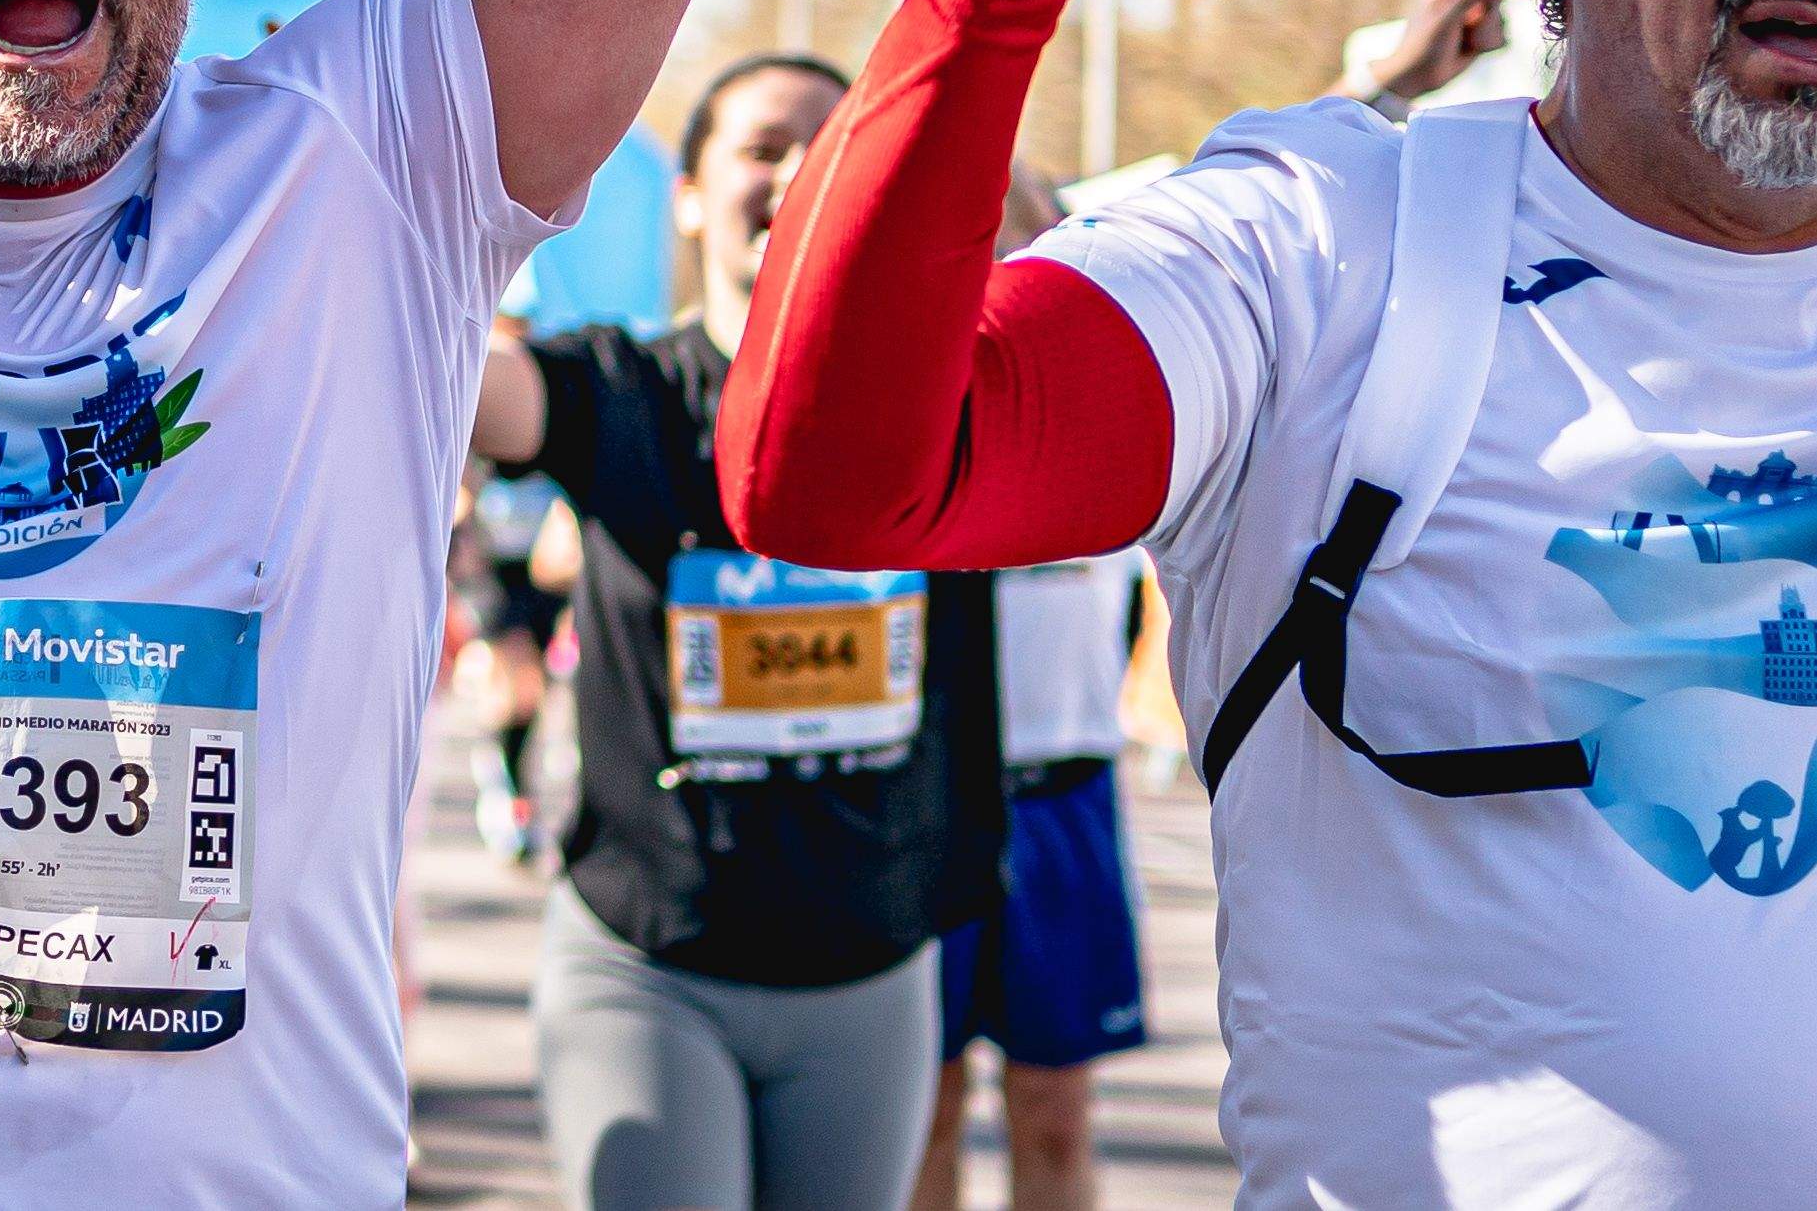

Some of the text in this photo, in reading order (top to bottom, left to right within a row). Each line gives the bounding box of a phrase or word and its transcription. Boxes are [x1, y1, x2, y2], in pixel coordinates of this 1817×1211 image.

[4, 628, 186, 669] Movistar
[15, 716, 64, 729] MEDIO
[67, 718, 137, 734] MARATÓN
[140, 723, 171, 737] 2023
[218, 959, 233, 970] XL
[107, 1007, 224, 1034] MADRID
